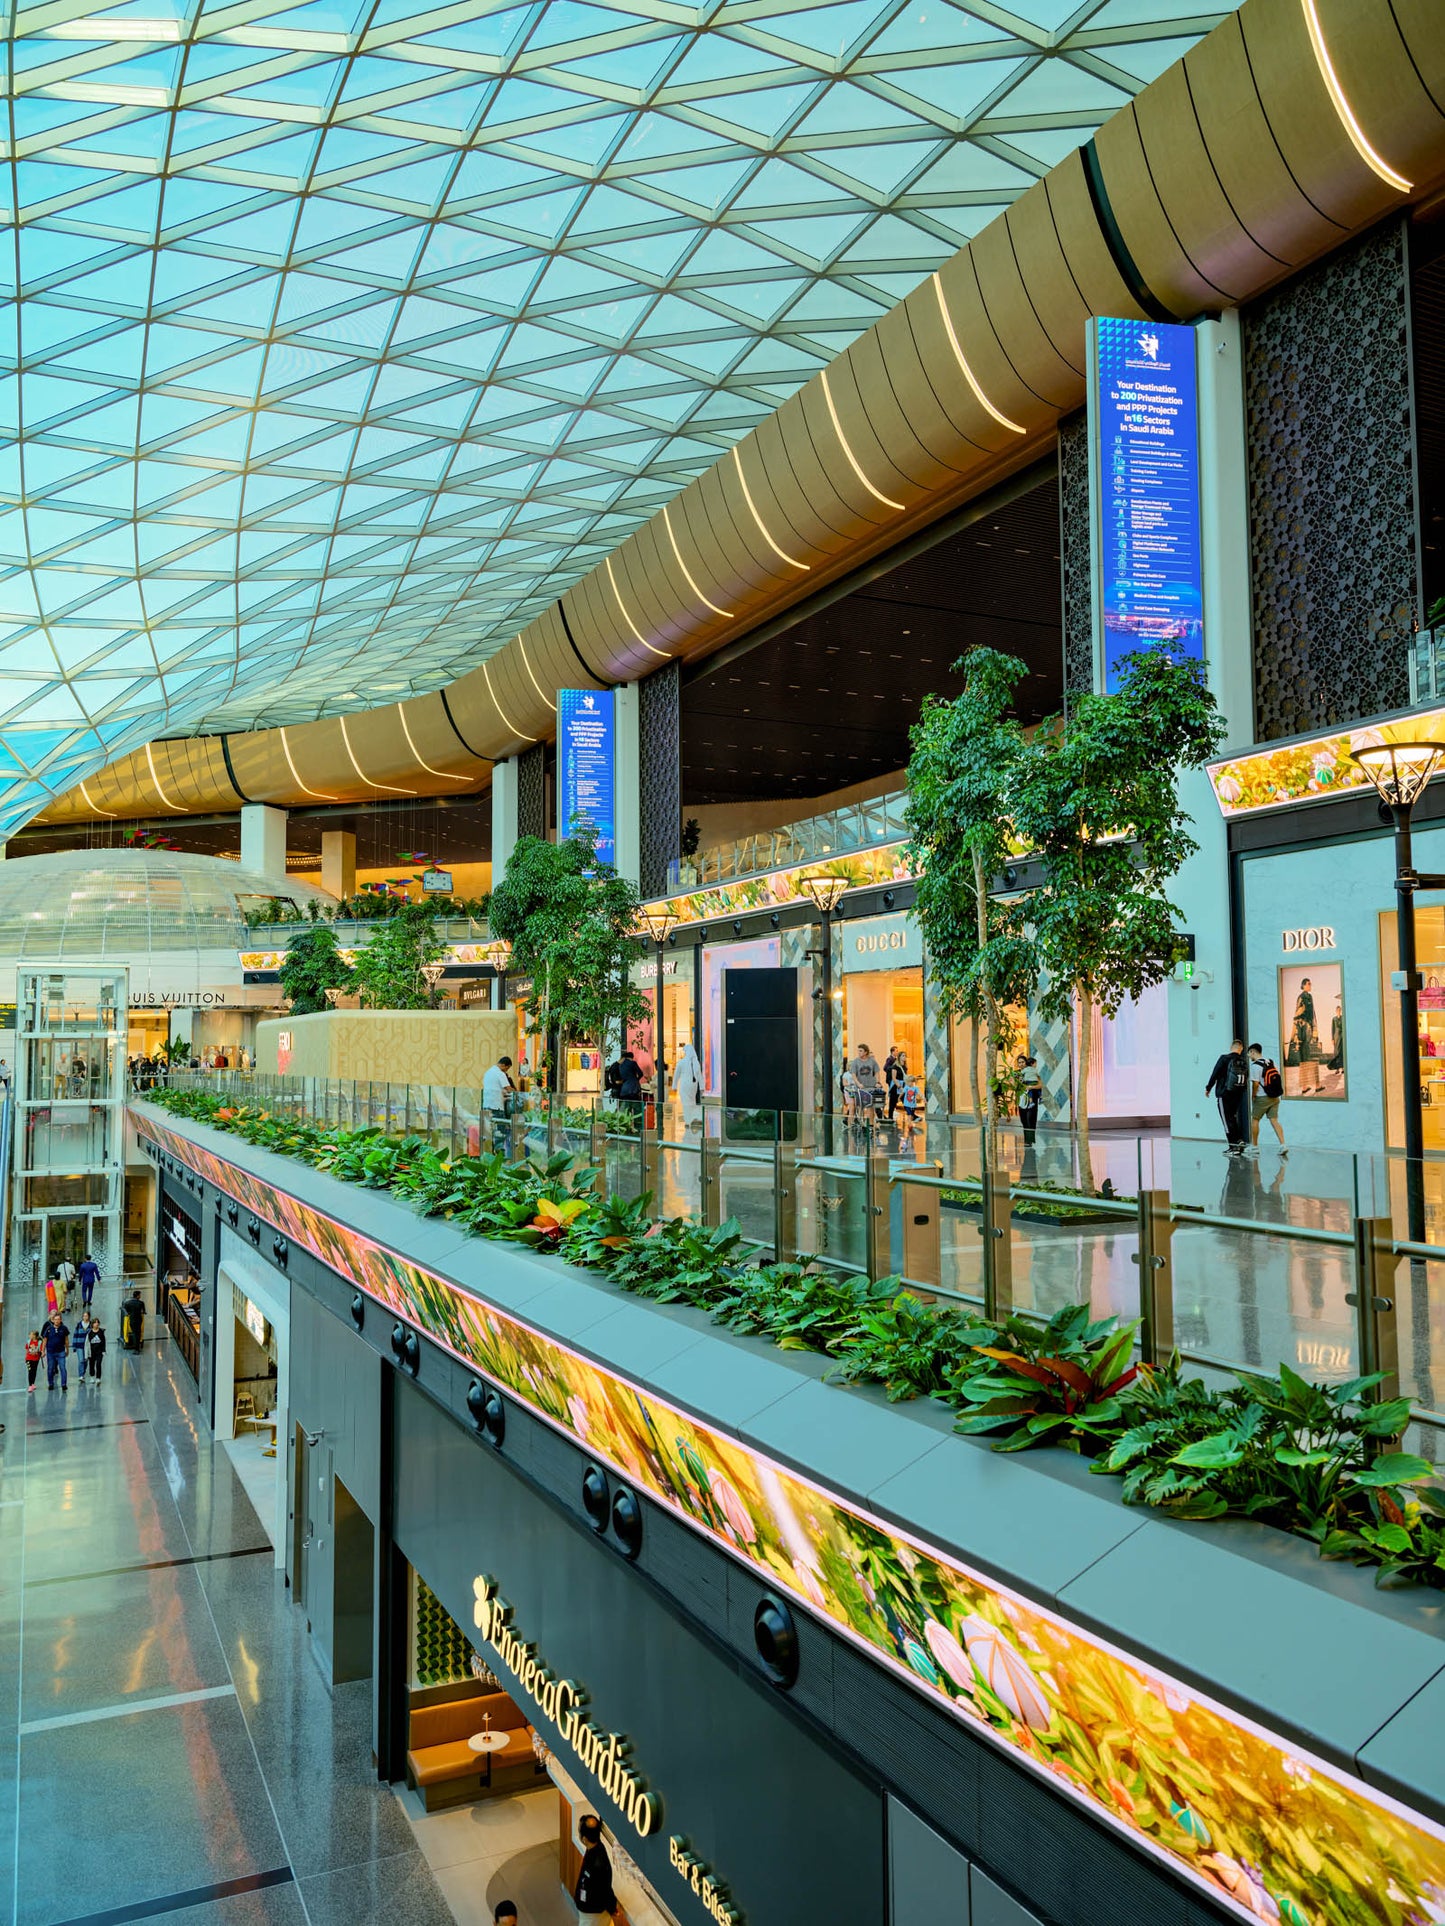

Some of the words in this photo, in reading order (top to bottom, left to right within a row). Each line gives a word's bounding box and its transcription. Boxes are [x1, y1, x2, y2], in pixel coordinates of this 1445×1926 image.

[1117, 381, 1133, 389] Your
[1135, 383, 1176, 393] Destination
[1121, 392, 1136, 400] 200
[1138, 394, 1182, 405] Privatization
[1148, 405, 1178, 415] Projects
[1132, 414, 1142, 422] 16
[1143, 416, 1170, 425] Sectors
[1129, 424, 1149, 433] Saudi
[1151, 426, 1174, 435] Arabia
[855, 930, 907, 955] GUCCI
[1282, 926, 1336, 953] DIOR
[640, 961, 678, 978] BURBRRY
[161, 992, 225, 1004] VUITTON
[669, 1835, 690, 1881] Bar
[690, 1864, 700, 1897] &
[702, 1876, 732, 1926] Bites
